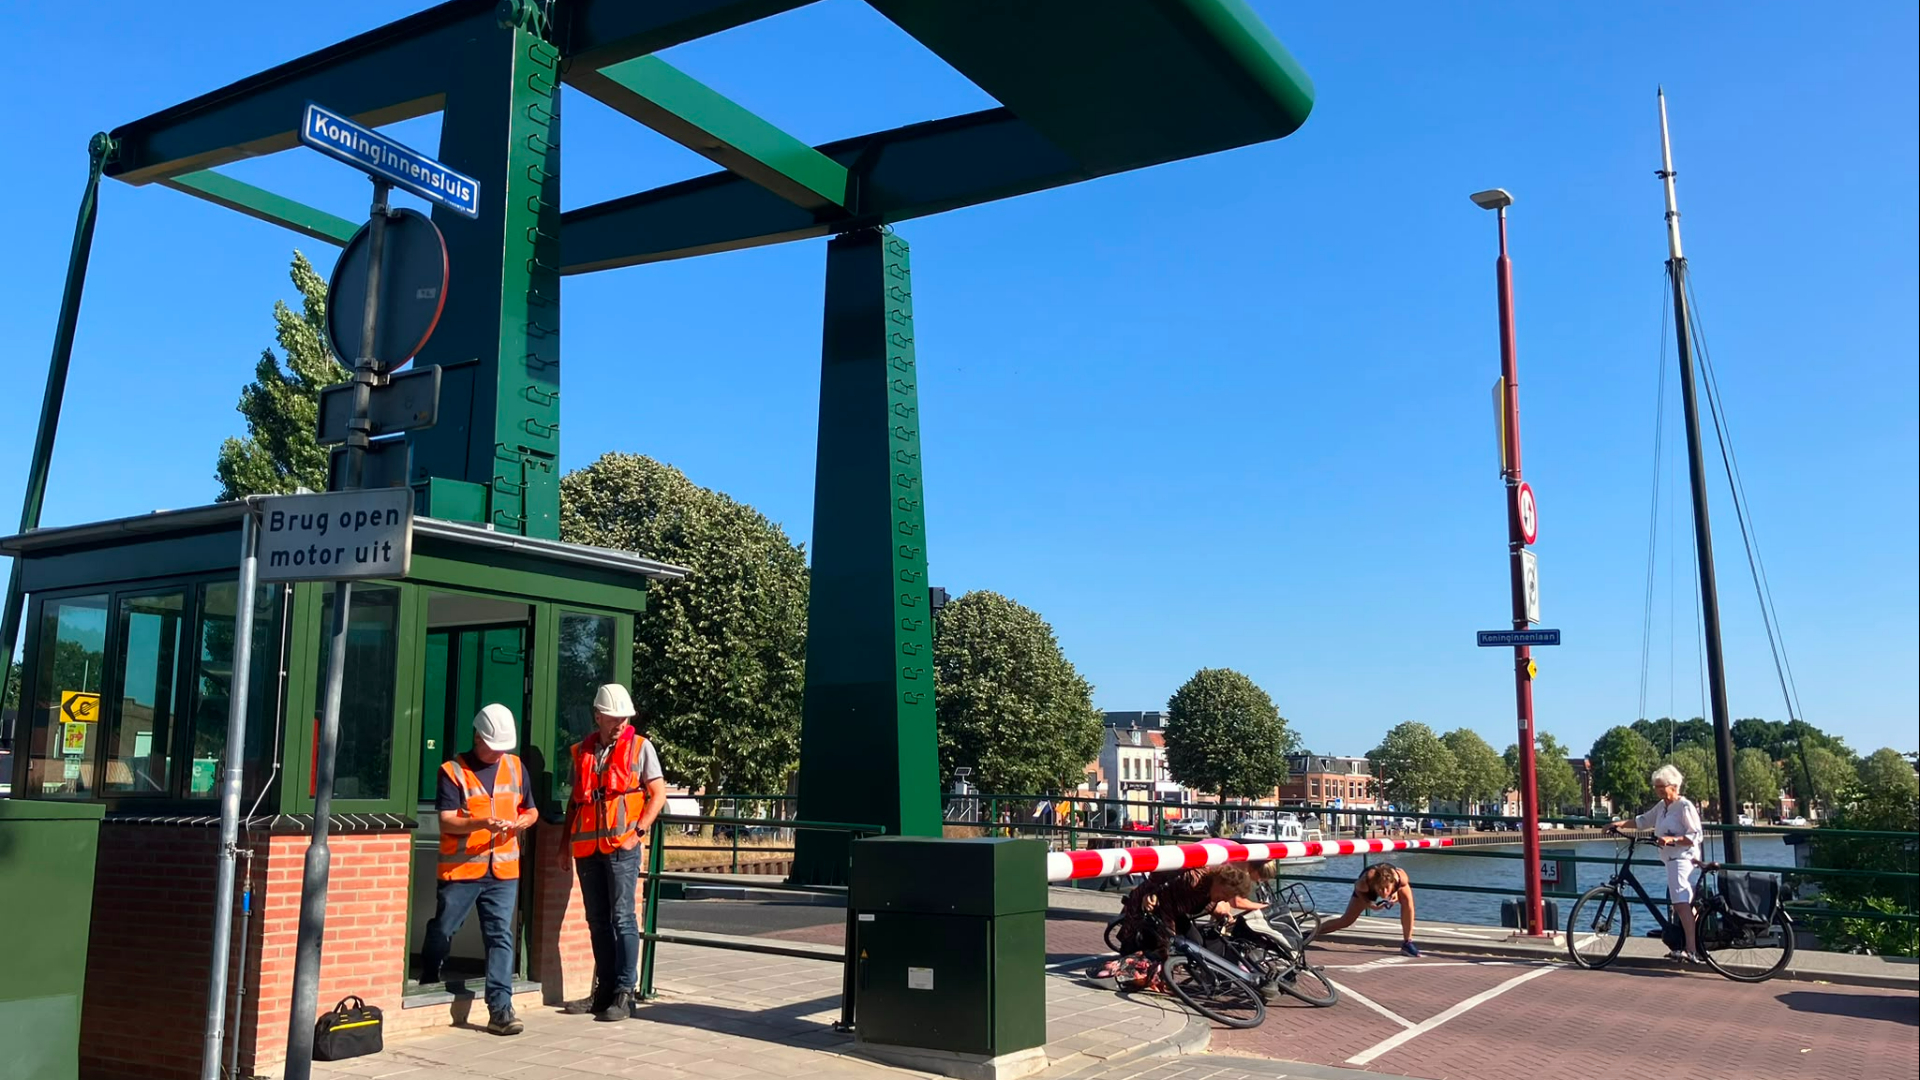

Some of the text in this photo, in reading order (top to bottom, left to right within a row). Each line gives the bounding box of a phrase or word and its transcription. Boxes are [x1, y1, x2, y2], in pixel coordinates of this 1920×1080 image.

[315, 114, 470, 201] Koninginnensluis
[270, 508, 399, 536] Brug open
[270, 540, 391, 567] motor uit
[1482, 633, 1555, 643] Koninginnenlaan
[1540, 863, 1556, 877] 4,5
